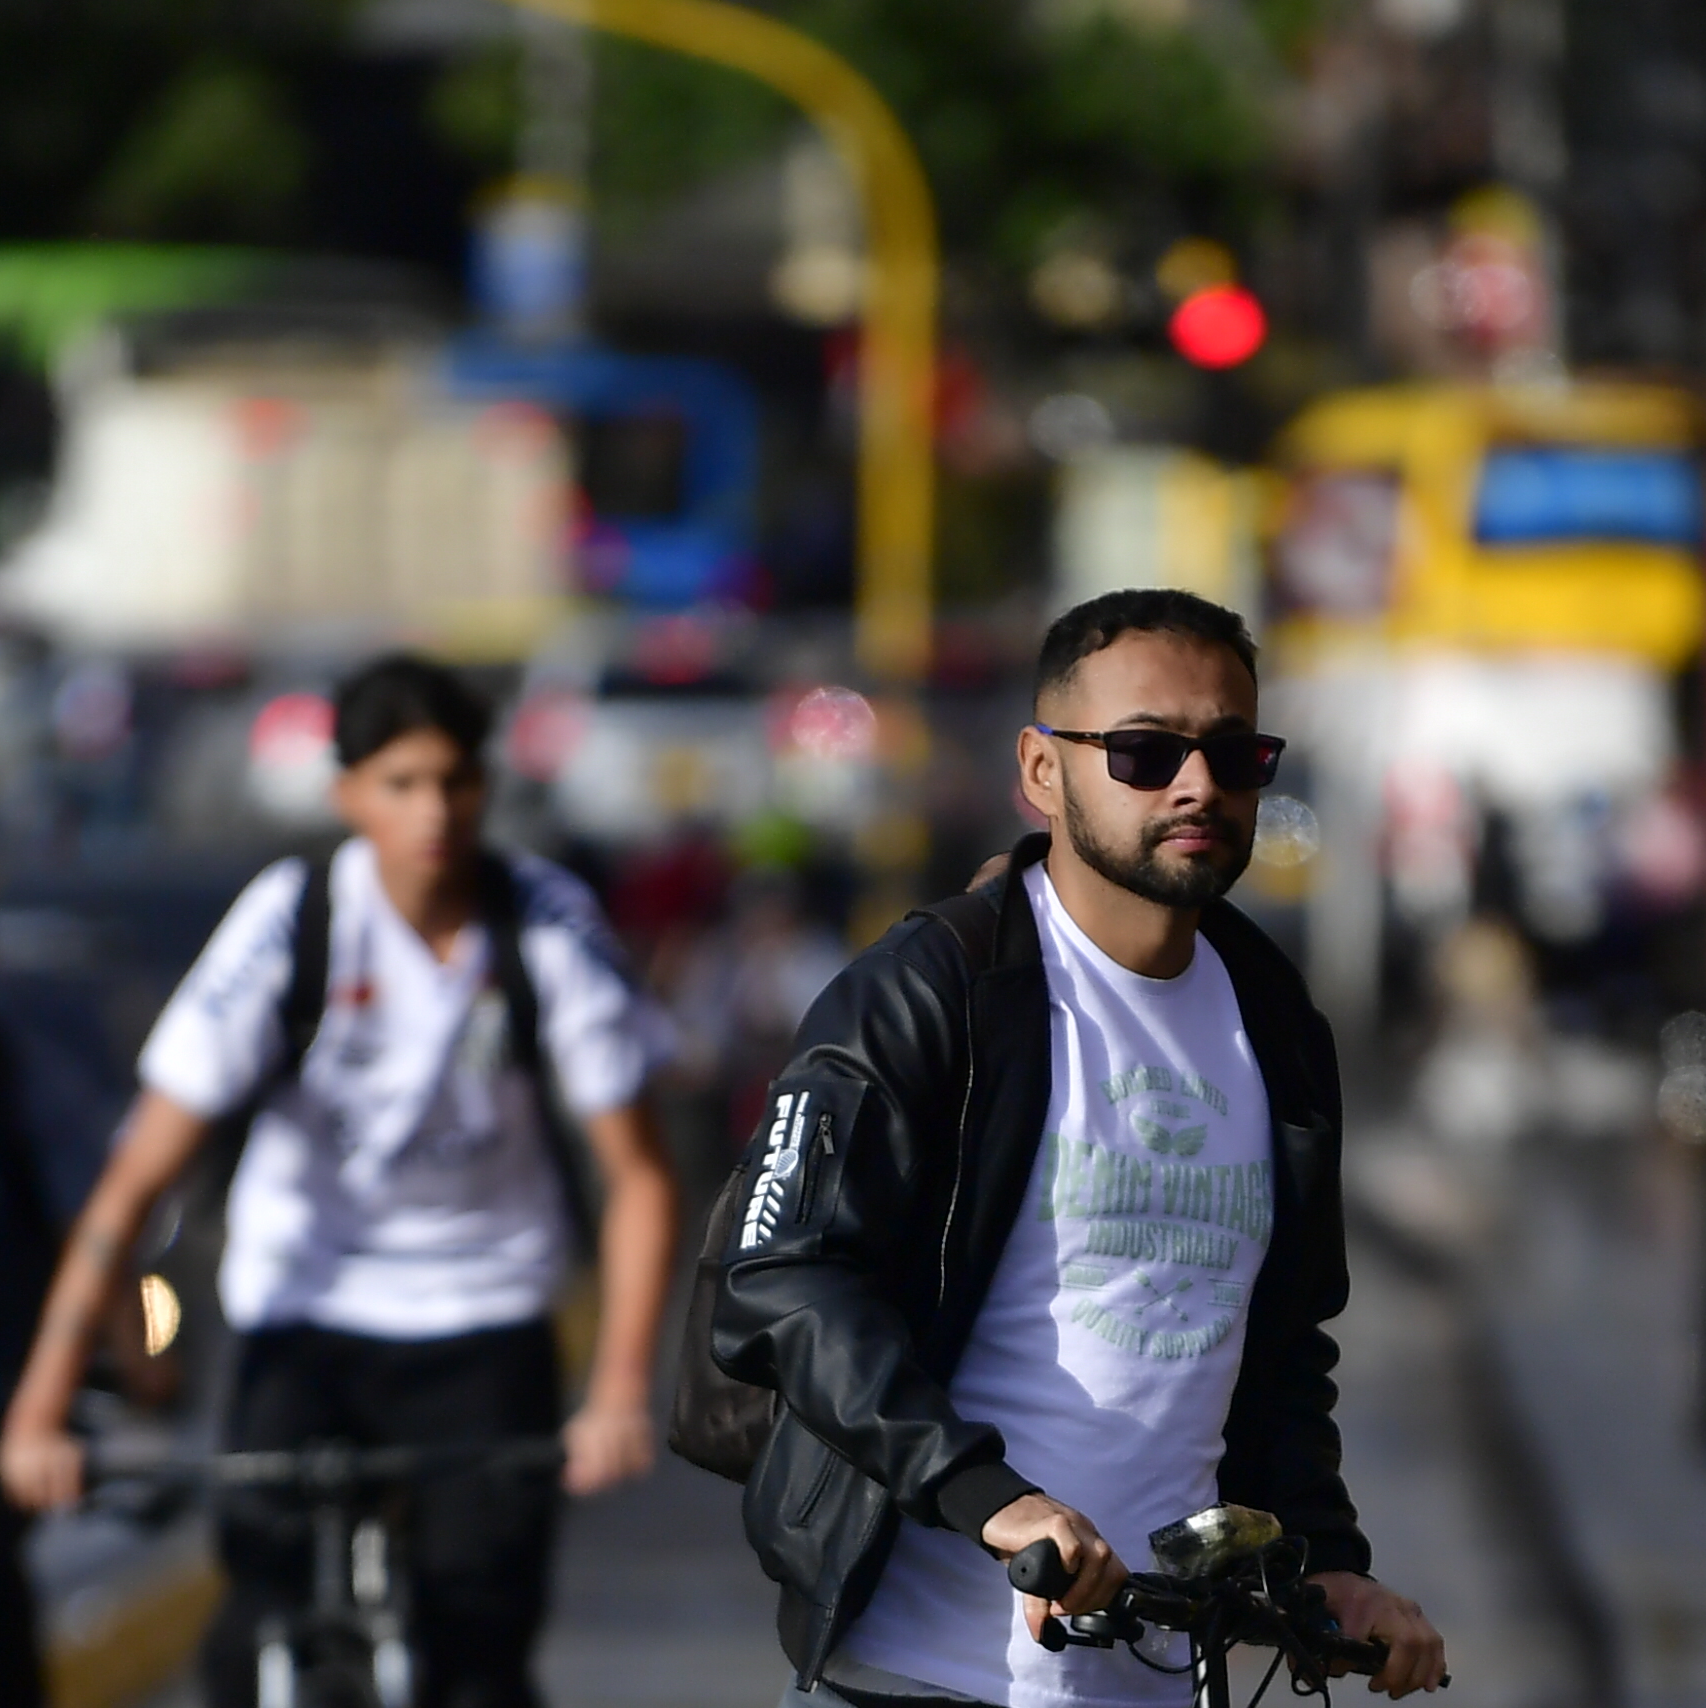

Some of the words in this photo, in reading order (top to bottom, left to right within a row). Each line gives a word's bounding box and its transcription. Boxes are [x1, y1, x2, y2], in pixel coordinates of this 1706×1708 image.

[741, 1093, 794, 1249] FUTURE
[1038, 1132, 1151, 1221] DENIM
[1071, 1298, 1148, 1355] QUALITY
